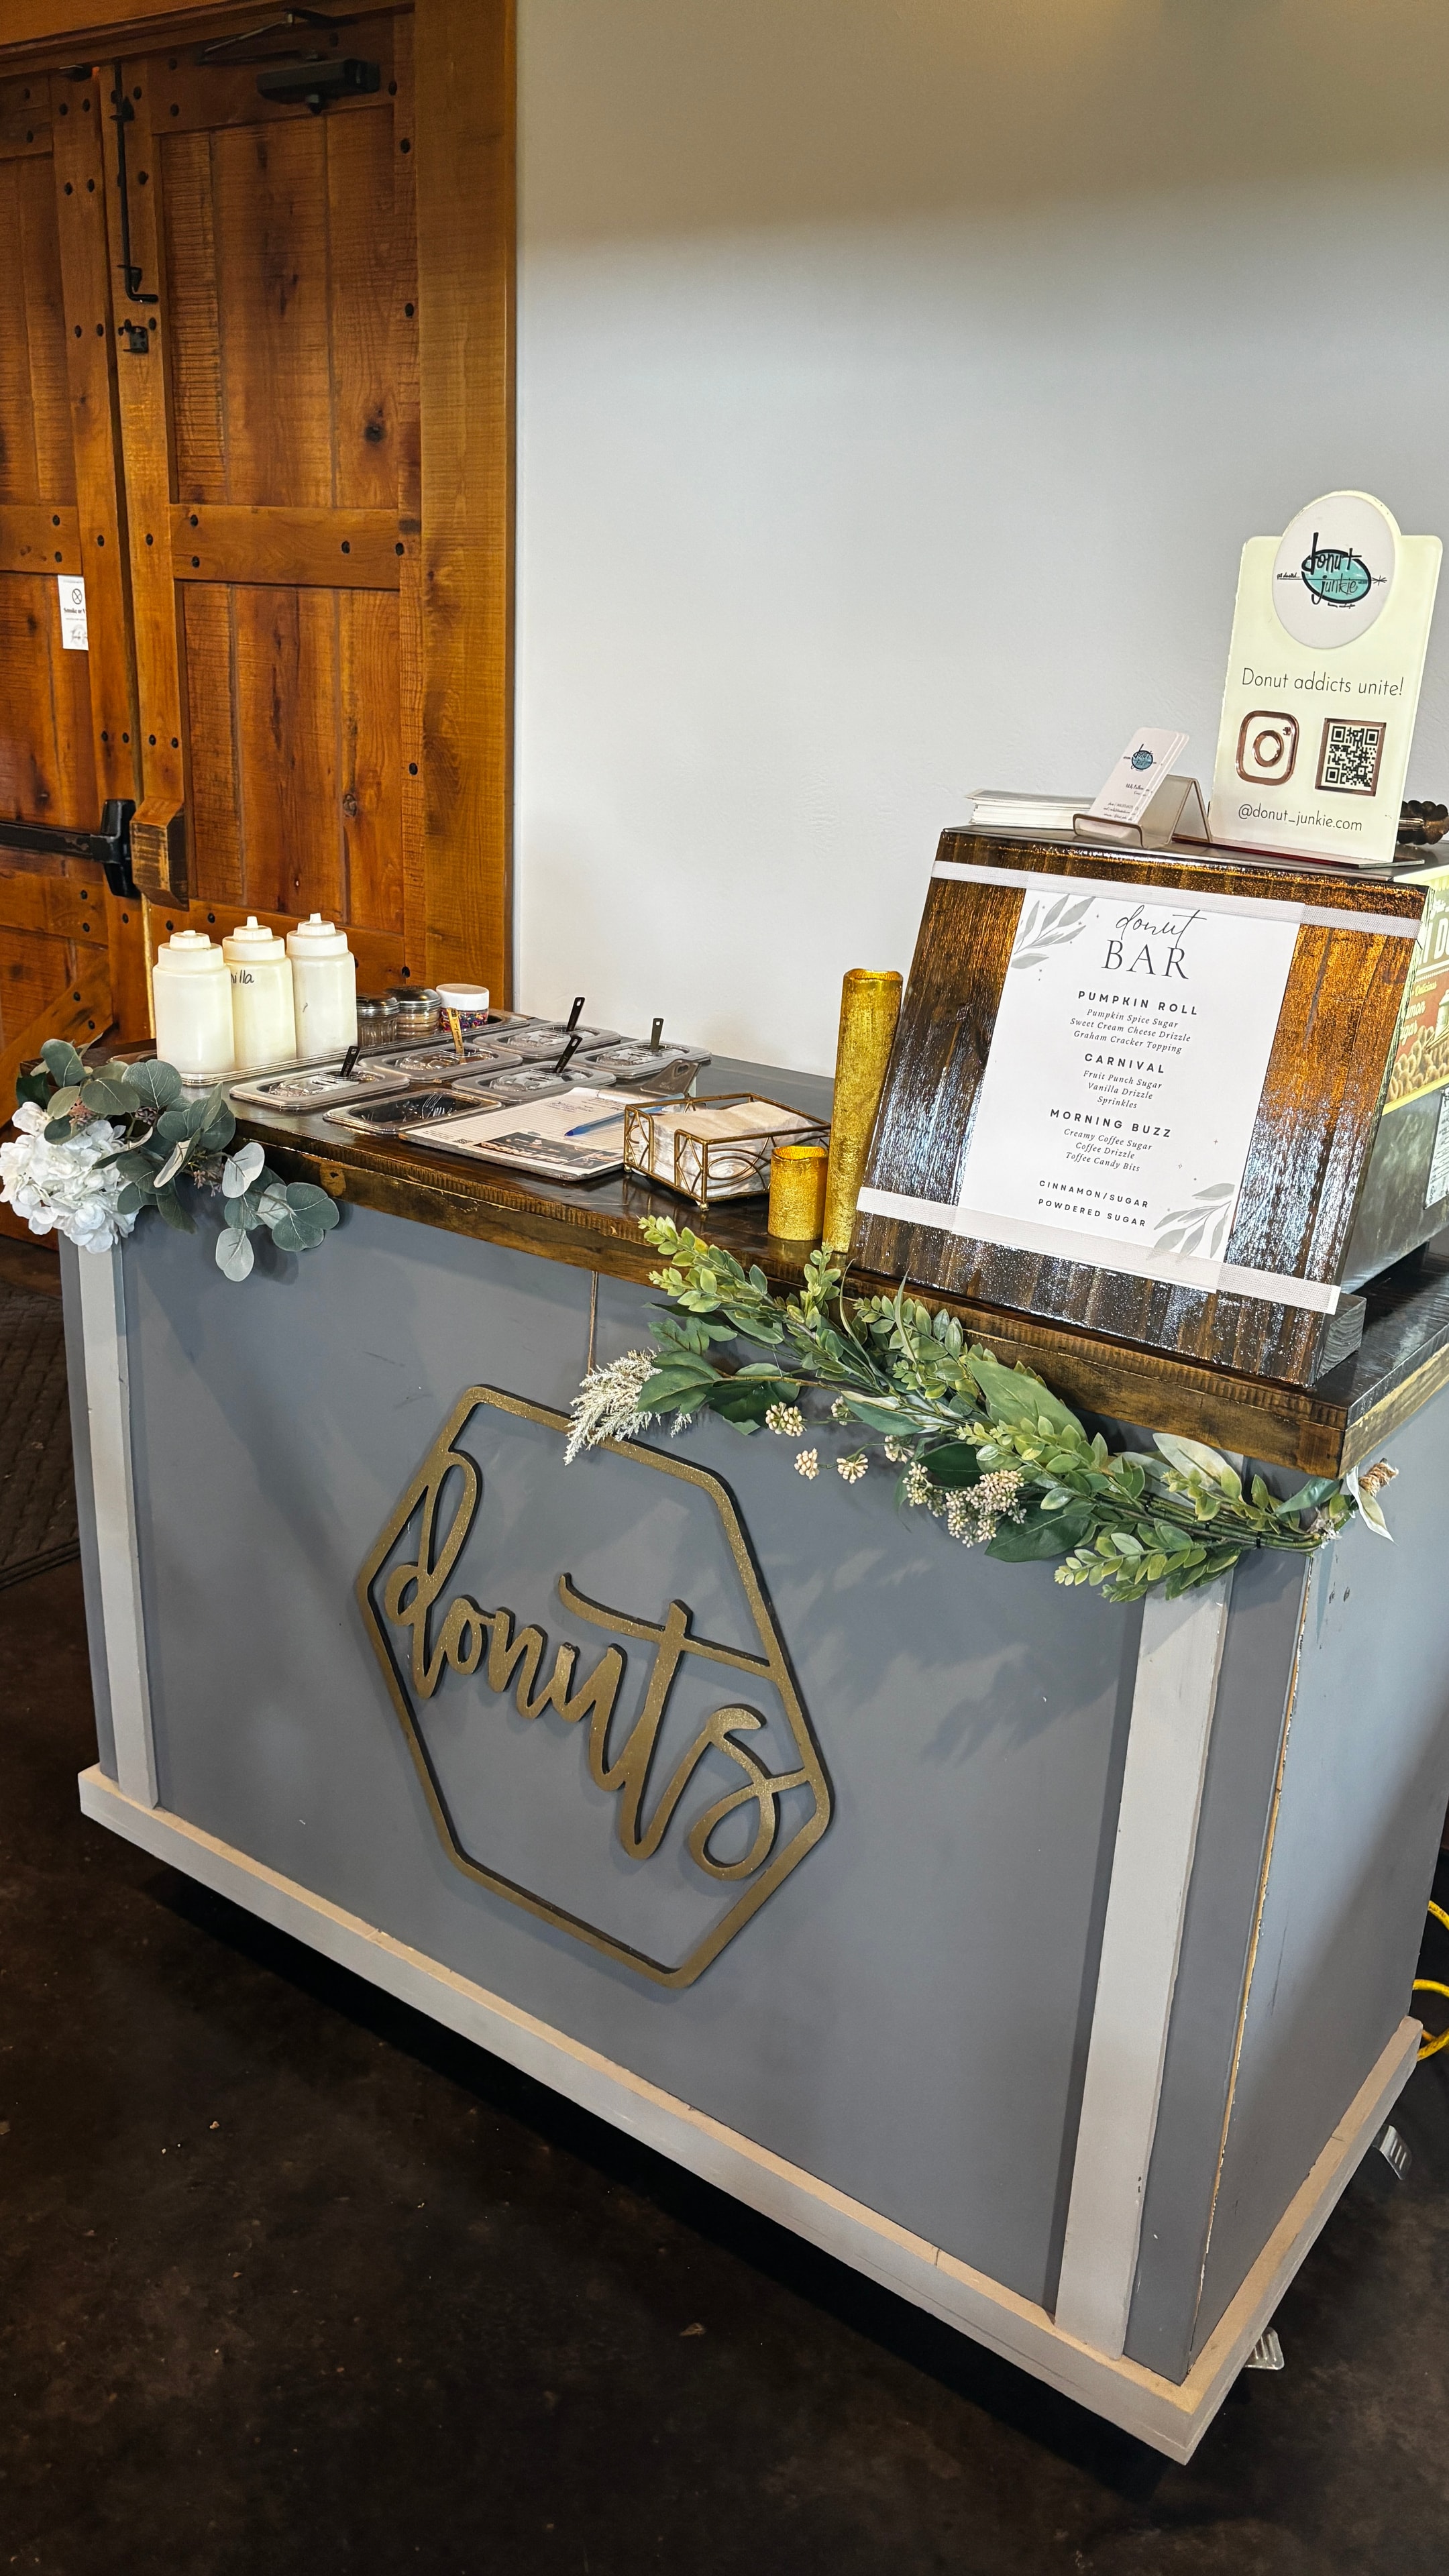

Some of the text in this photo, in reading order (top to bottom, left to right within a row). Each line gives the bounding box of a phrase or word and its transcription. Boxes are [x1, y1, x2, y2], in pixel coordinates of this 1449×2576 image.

[1301, 532, 1362, 575] donut
[1311, 573, 1358, 604] junkie
[1242, 667, 1403, 696] Donut addicts unite!
[1238, 803, 1362, 831] @donut_junkie.com
[1116, 905, 1207, 949] donut
[1101, 940, 1189, 979] BAR
[1078, 991, 1197, 1015] PUMPKIN ROLL
[1070, 1018, 1191, 1042] Sweet Cream Cheese Drizzle
[1087, 1009, 1179, 1028] Pumpkin Spice Sugar
[1074, 1030, 1182, 1055] Graham Cracker Topping
[1085, 1053, 1164, 1073] CARNIVAL
[1083, 1070, 1163, 1089] Fruit Punch Sugar
[1088, 1082, 1153, 1099] Vanilla Drizzle
[1097, 1096, 1137, 1109] Sprinkles
[1050, 1109, 1171, 1137] MORNING BUZZ
[1064, 1128, 1153, 1150] Creamy Coffee Sugar
[1075, 1142, 1135, 1159] Coffee Drizzle
[1066, 1152, 1140, 1172] Toffee Candy Bits
[1039, 1180, 1148, 1208] CINNAMON/SUGAR
[1038, 1199, 1146, 1226] POWDERED SUGAR
[384, 1447, 808, 1880] donuts
